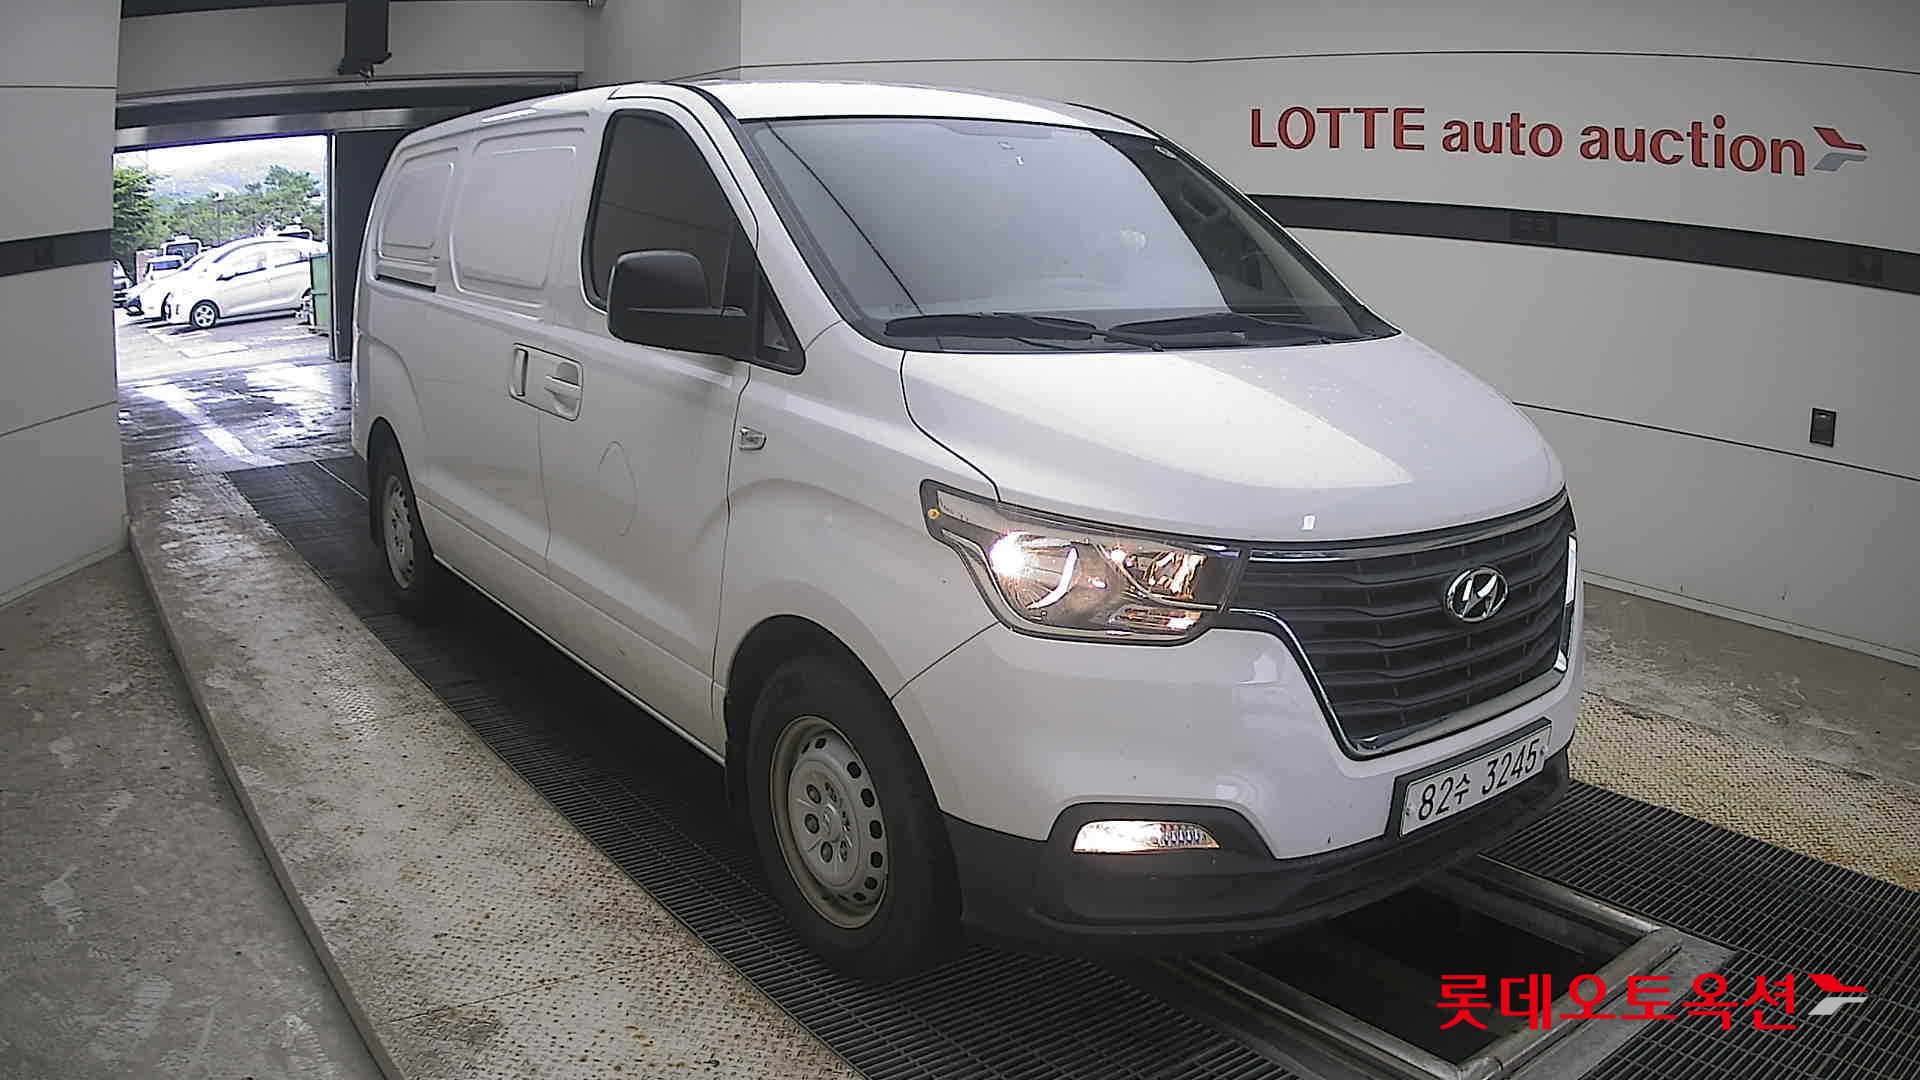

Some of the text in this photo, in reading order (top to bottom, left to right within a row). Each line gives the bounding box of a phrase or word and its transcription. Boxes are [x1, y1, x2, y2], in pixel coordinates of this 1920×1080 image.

[1250, 106, 1806, 177] LOTTE auto auction
[1418, 737, 1541, 821] 82수 3245
